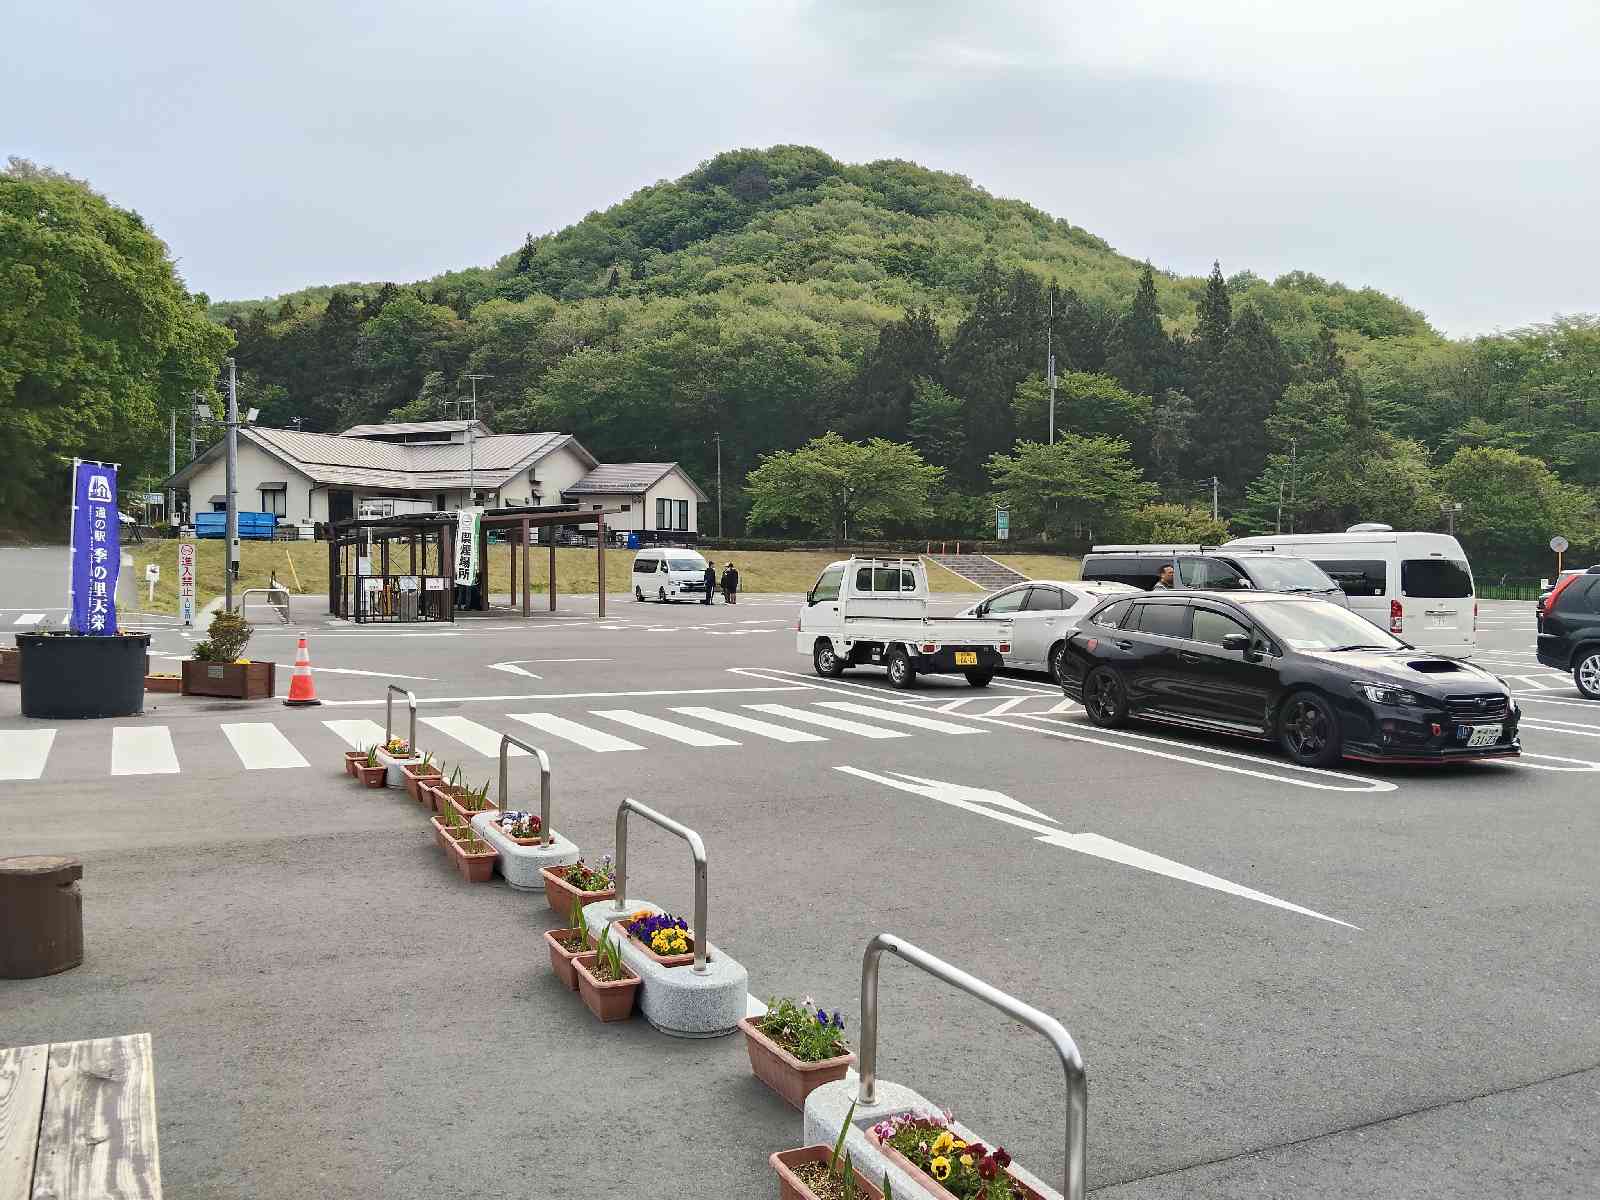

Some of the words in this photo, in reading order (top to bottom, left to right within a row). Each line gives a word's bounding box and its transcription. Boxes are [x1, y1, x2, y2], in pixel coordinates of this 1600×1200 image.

[181, 557, 192, 596] 進入禁止
[459, 532, 472, 580] 喫煙場所
